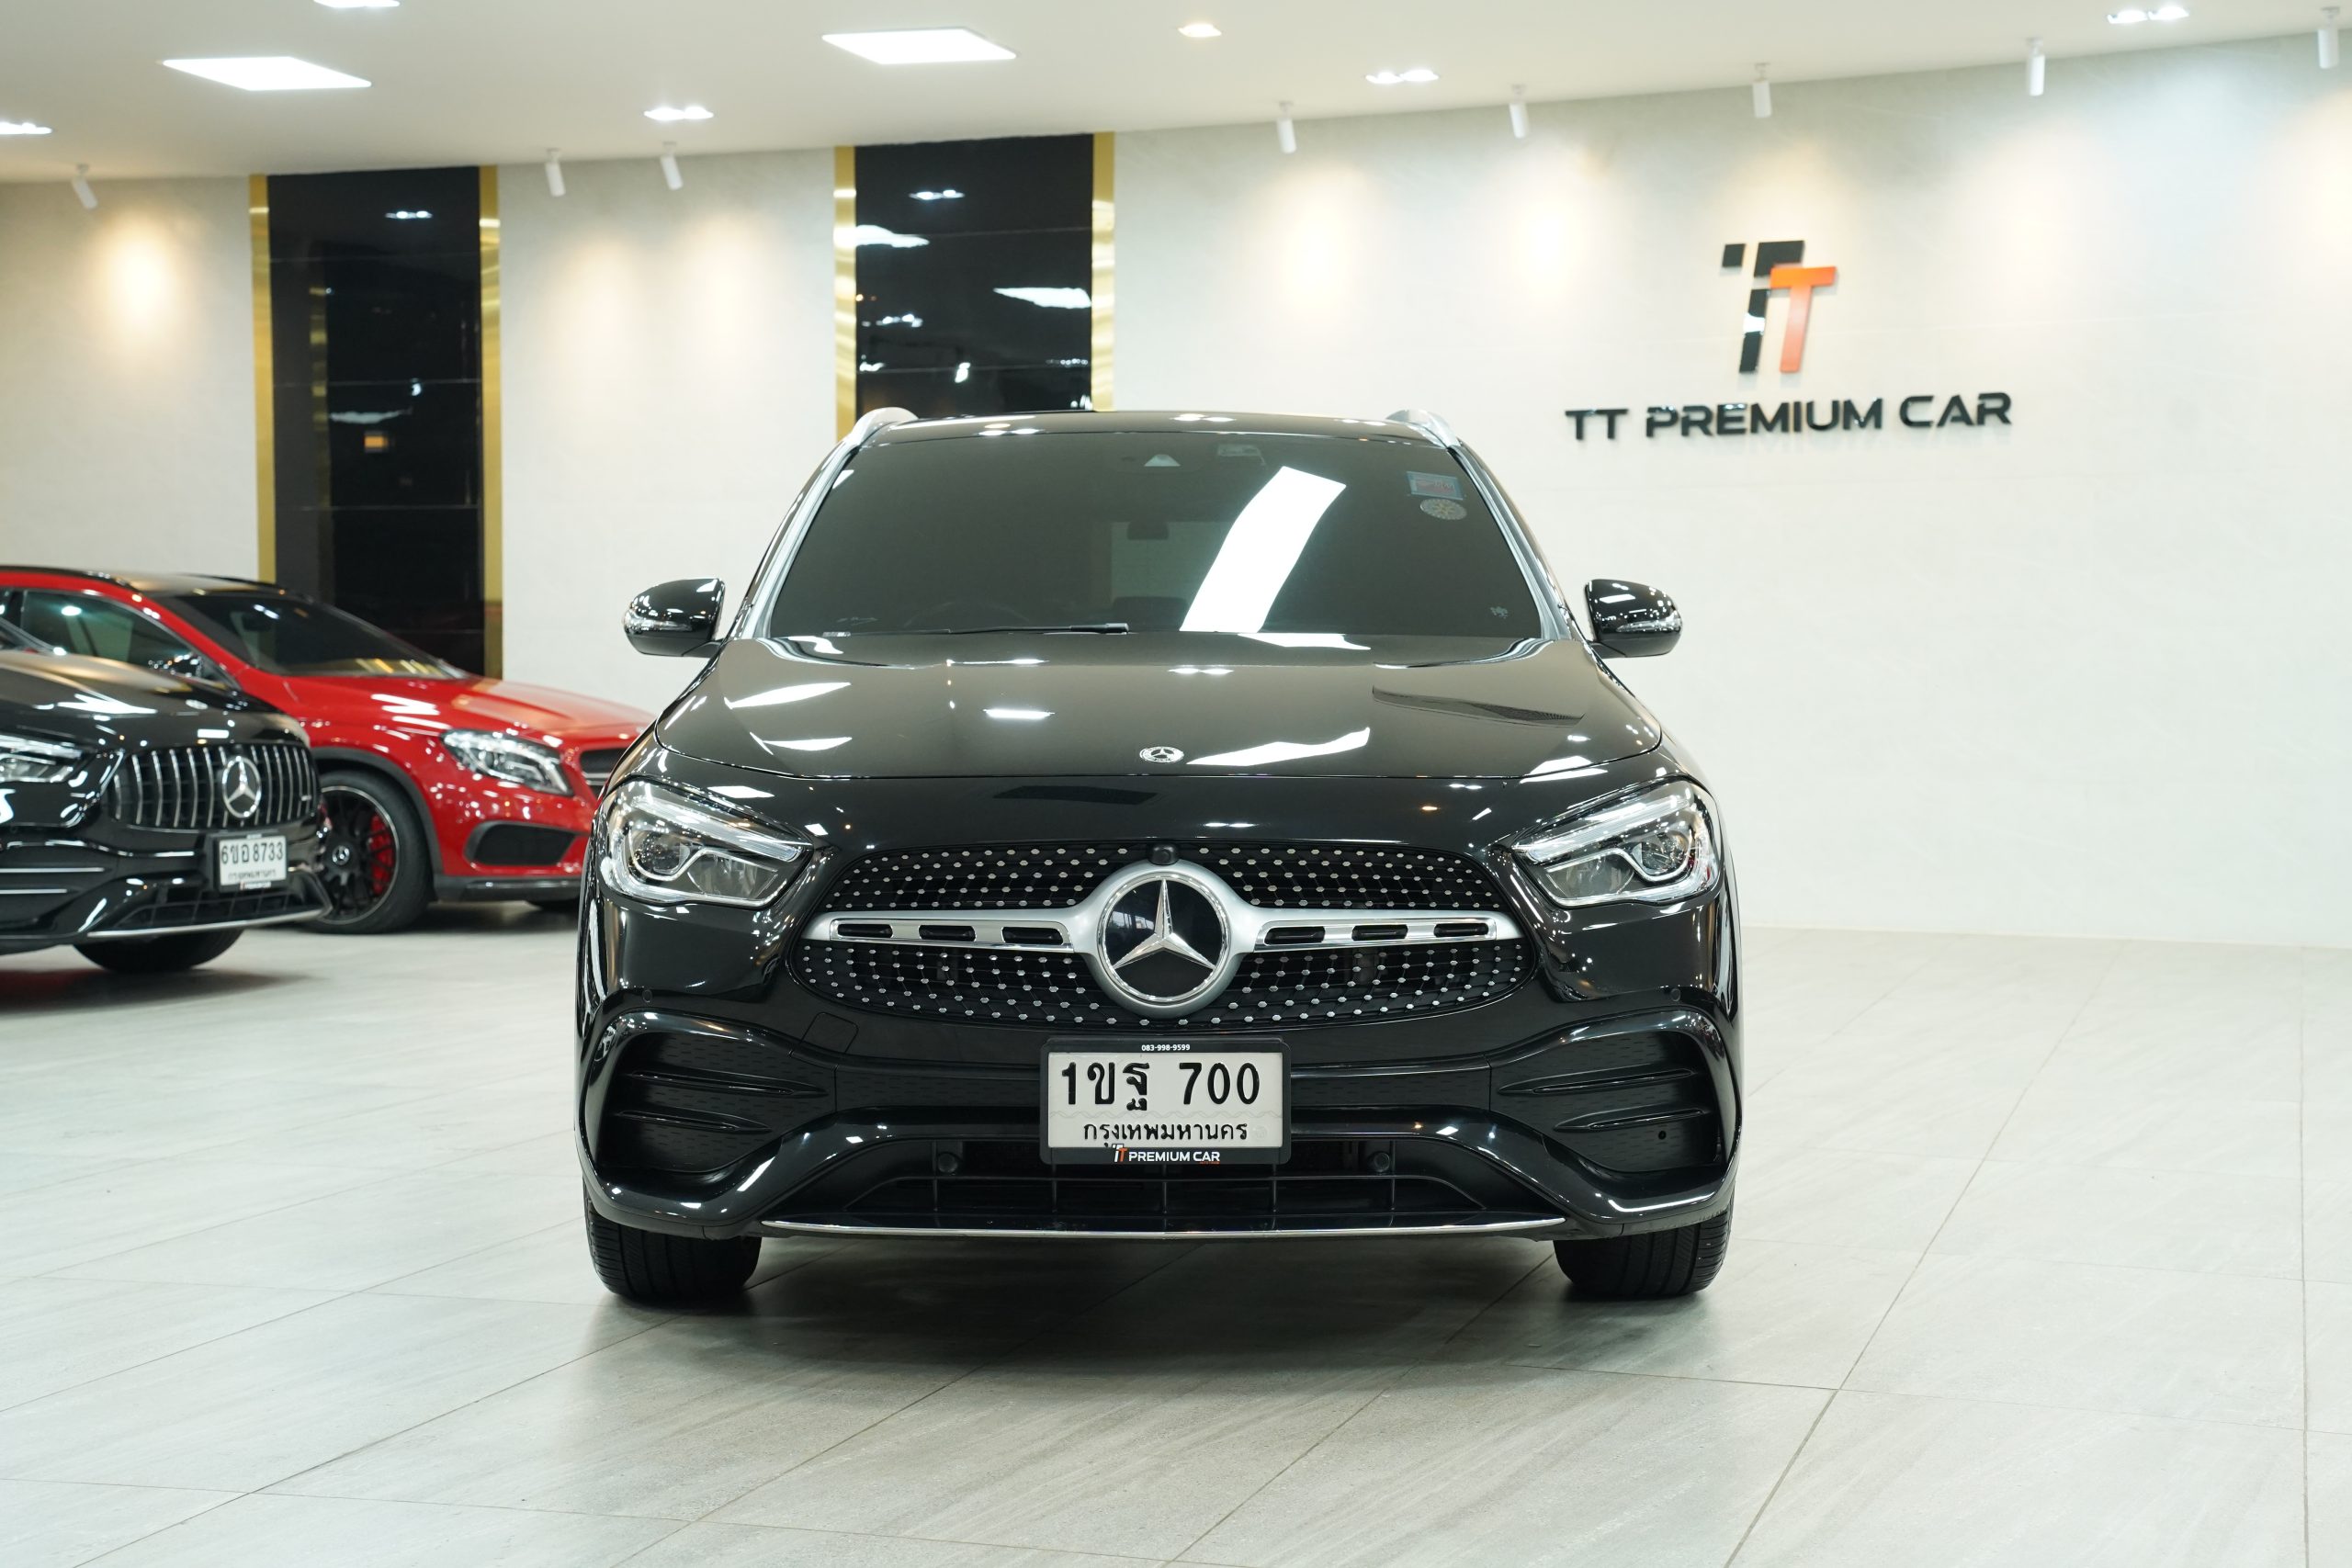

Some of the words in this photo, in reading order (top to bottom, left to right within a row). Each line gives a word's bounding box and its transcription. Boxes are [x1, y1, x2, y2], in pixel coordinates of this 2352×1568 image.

[1565, 409, 1629, 440] TT
[1645, 399, 1883, 438] PREMIUM
[1899, 391, 2013, 426] CAR
[253, 841, 283, 863] 8733
[1141, 1043, 1191, 1052] 083-998-9599
[1061, 1062, 1149, 1111] 1ขฐ
[1179, 1062, 1260, 1105] 700
[1084, 1123, 1248, 1147] กรุงเทพมหานคร
[1128, 1151, 1191, 1162] PREMIUM
[1193, 1151, 1220, 1162] CAR
